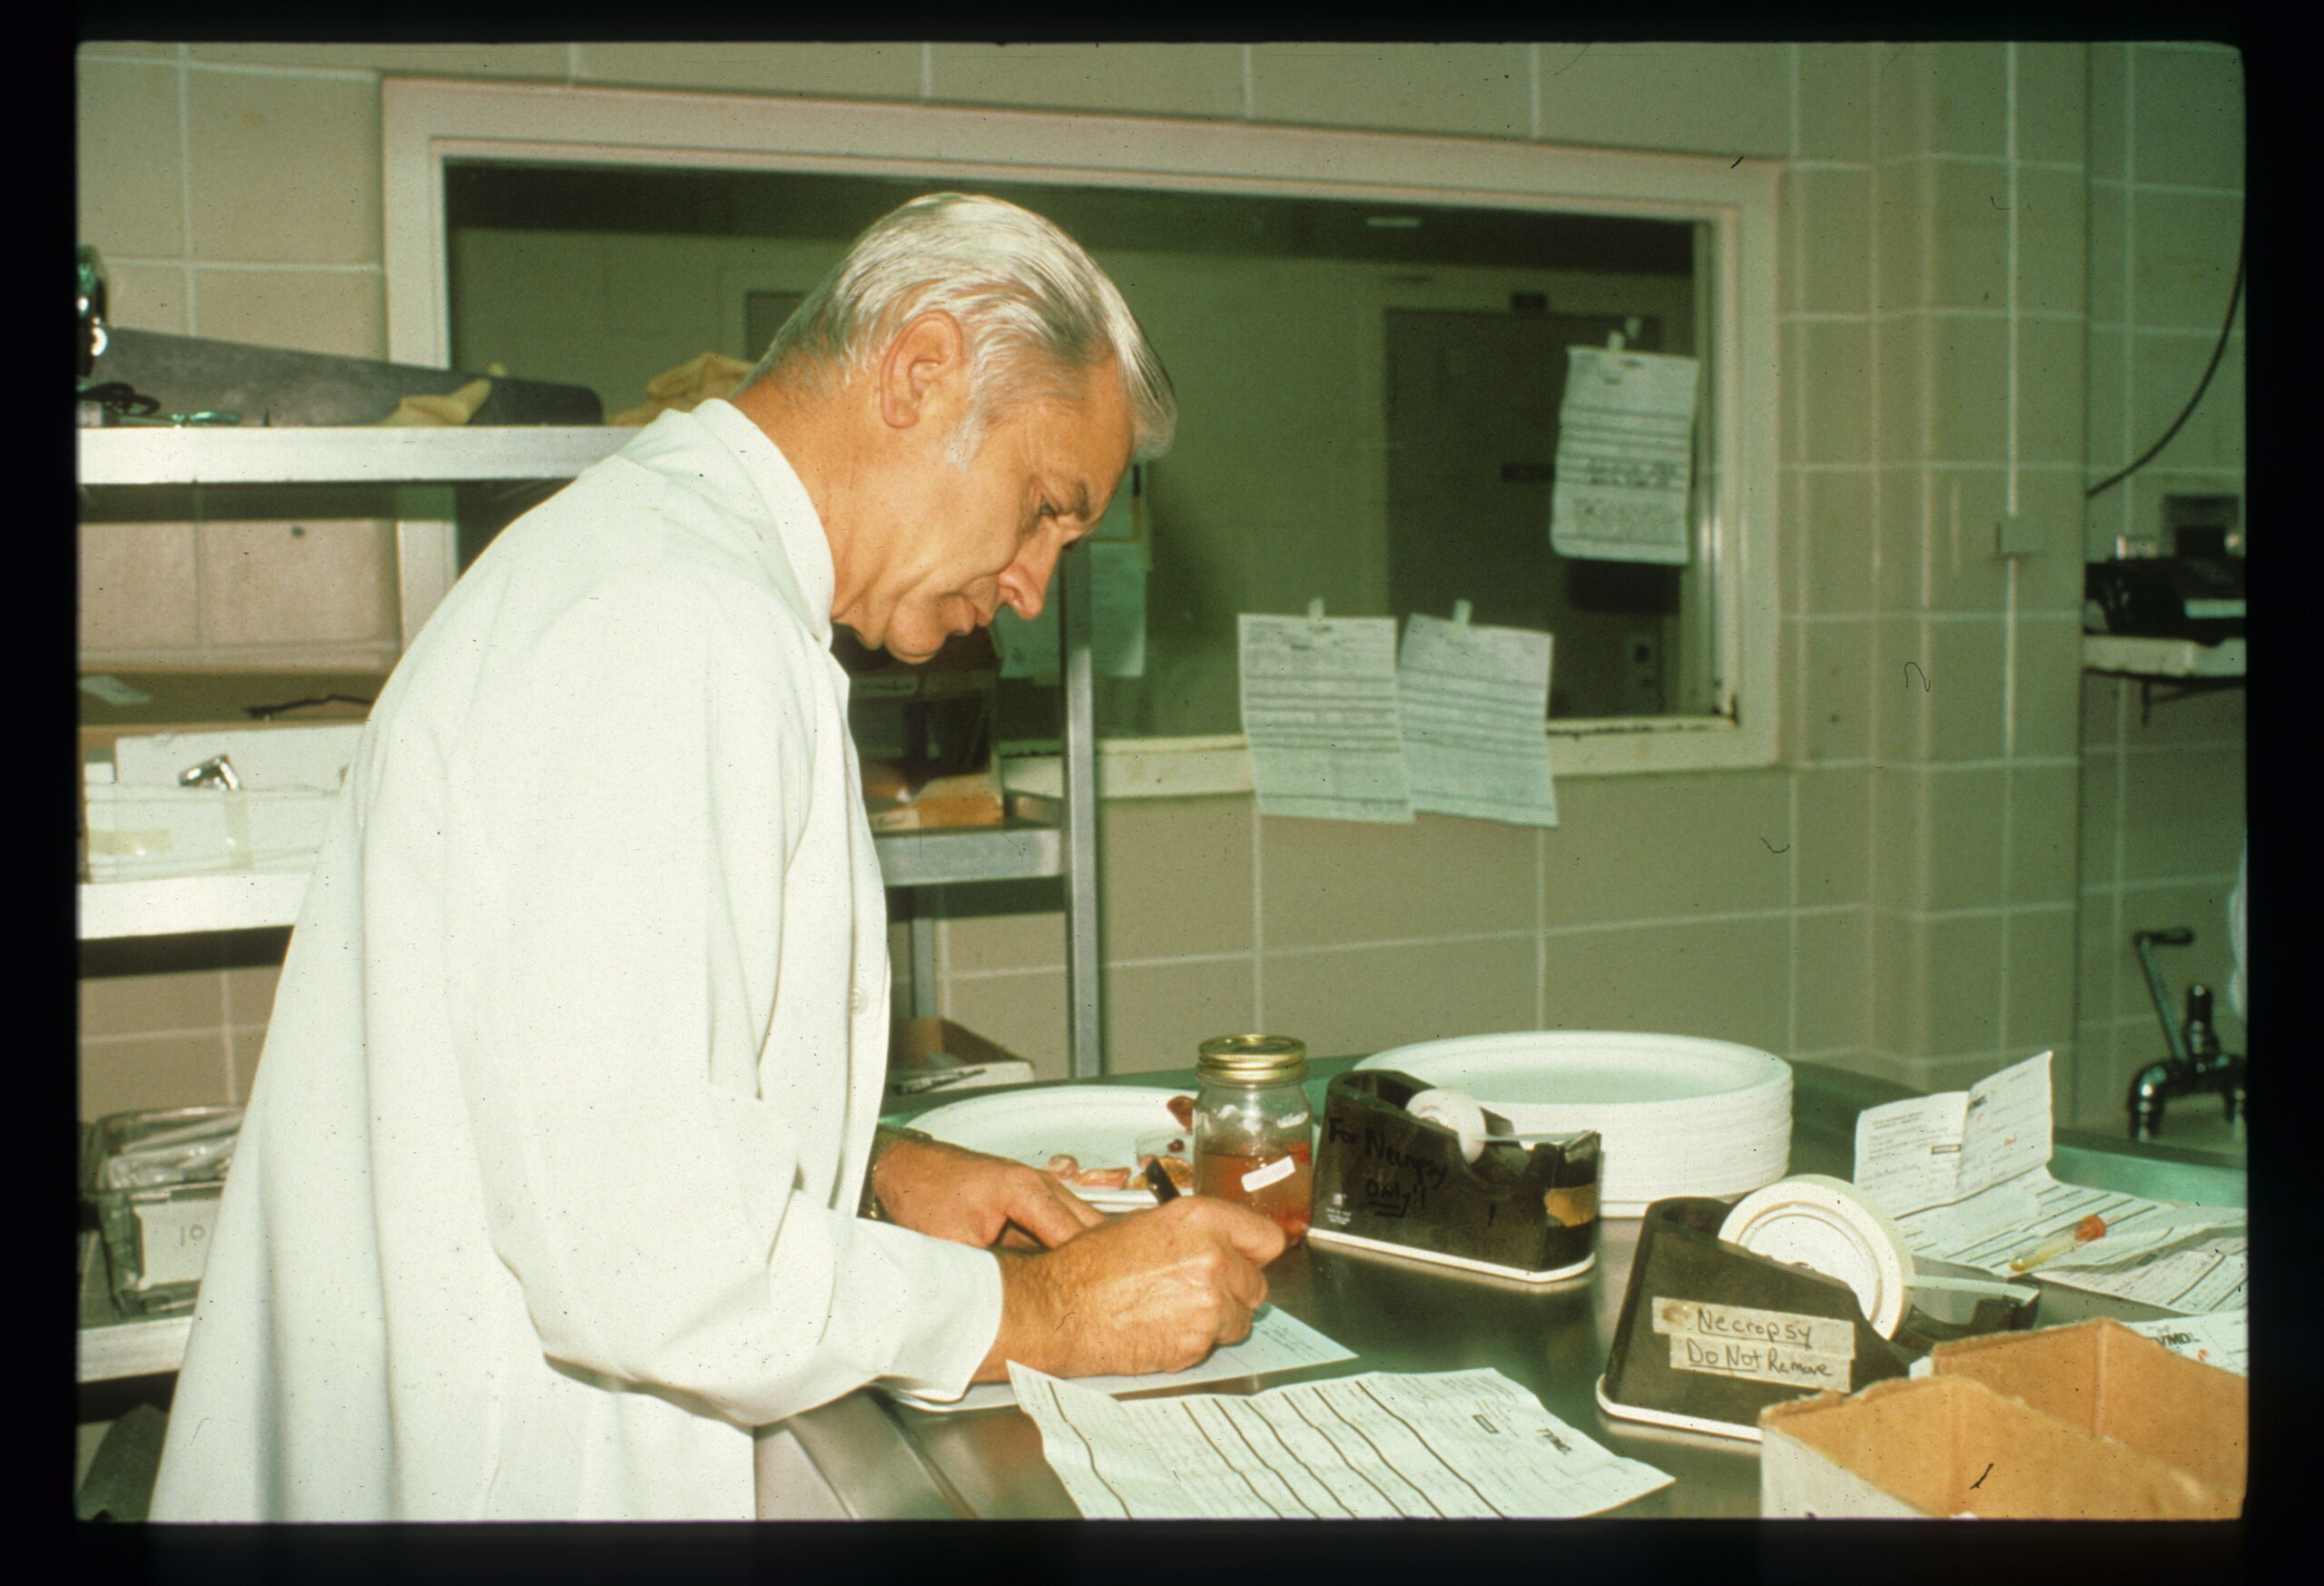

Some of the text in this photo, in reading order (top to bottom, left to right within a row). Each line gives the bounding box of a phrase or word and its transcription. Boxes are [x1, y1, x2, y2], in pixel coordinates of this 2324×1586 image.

[1328, 1118, 1358, 1144] For
[1697, 1307, 1813, 1350] Necropsy
[1686, 1337, 1833, 1377] Do Not Remove
